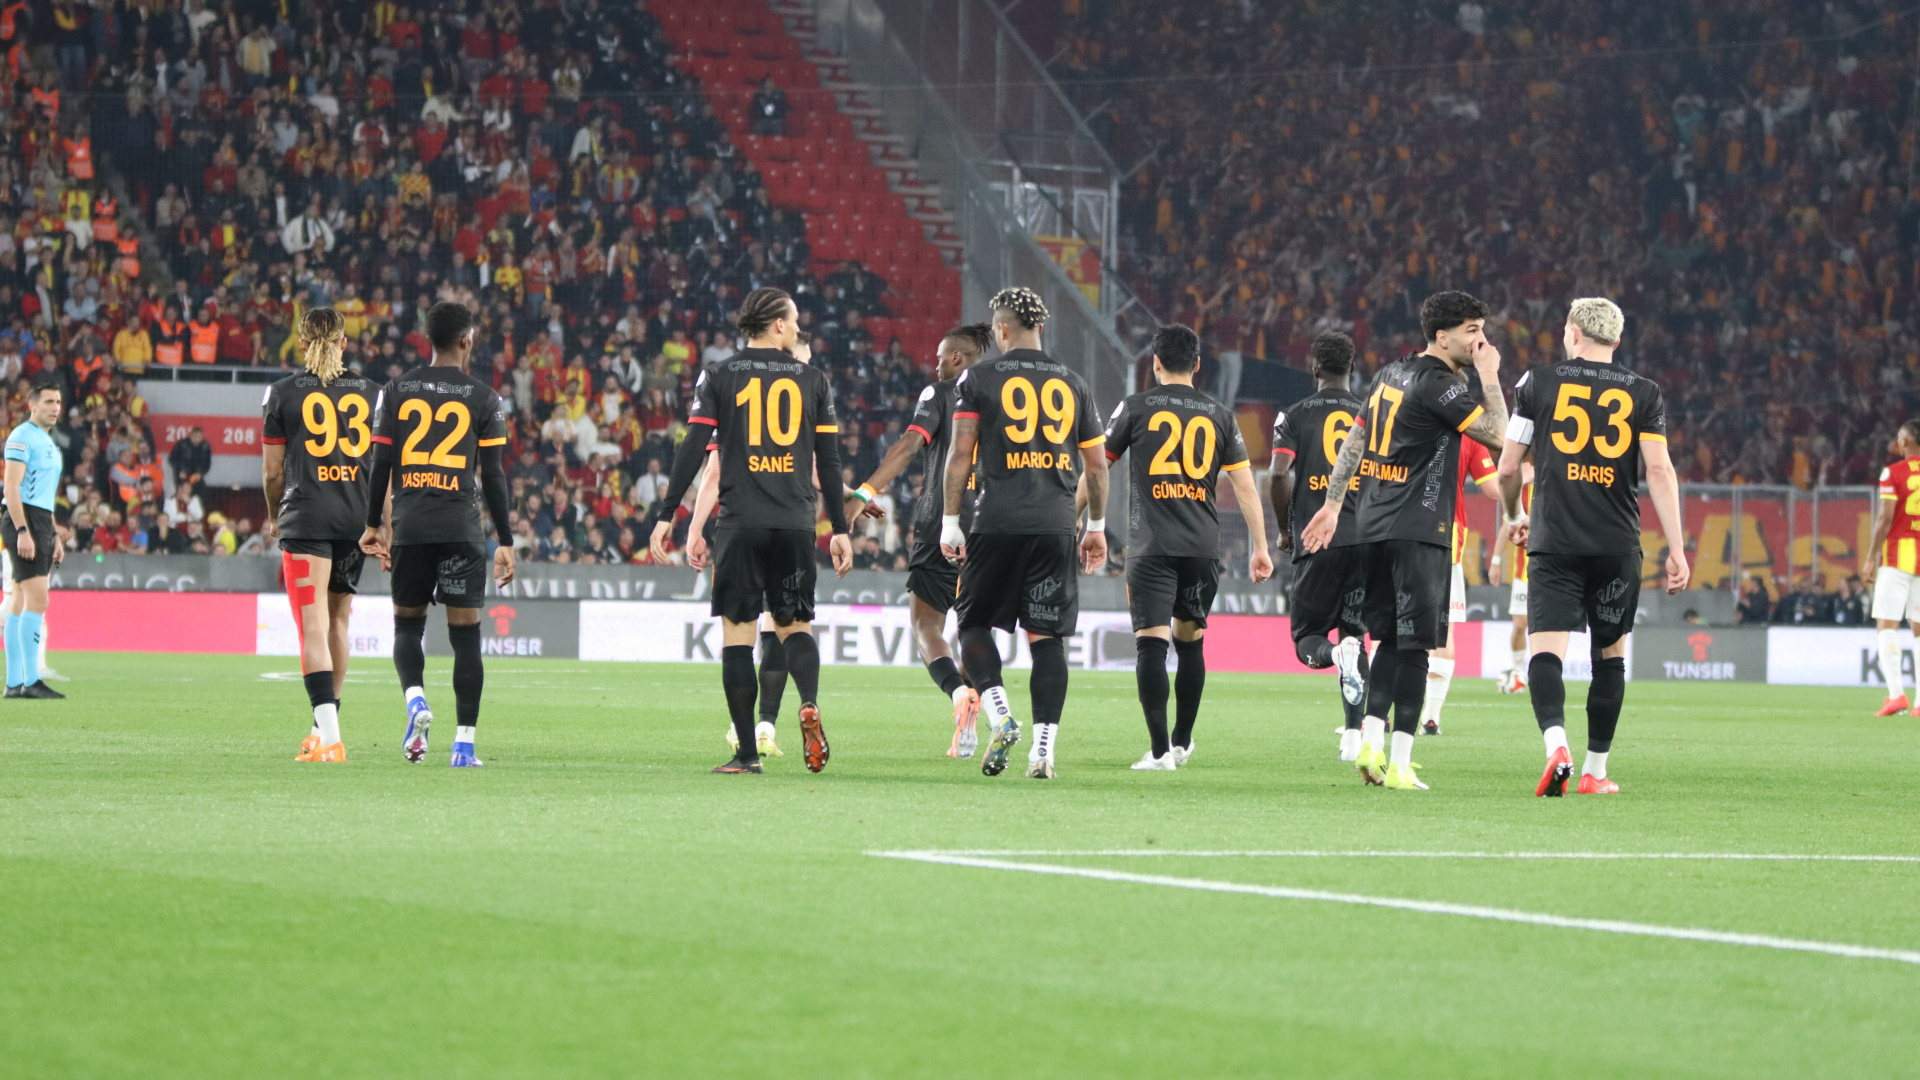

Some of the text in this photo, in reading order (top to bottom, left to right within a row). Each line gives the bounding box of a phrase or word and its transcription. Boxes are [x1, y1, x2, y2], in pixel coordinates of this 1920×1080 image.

[728, 360, 752, 371] CW
[995, 360, 1020, 372] CW
[1556, 365, 1582, 377] CW
[398, 381, 421, 392] CW
[1001, 376, 1075, 444] 99
[1145, 396, 1168, 406] CW
[736, 377, 803, 446] 10
[1368, 382, 1404, 457] 17
[1551, 383, 1634, 459] 53
[166, 426, 194, 442] 20
[302, 392, 371, 457] 93
[398, 398, 471, 469] 22
[223, 428, 255, 445] 208
[1148, 411, 1217, 480] 20
[1323, 411, 1354, 467] 6
[748, 452, 794, 473] SANÉ
[1006, 452, 1073, 471] MARIO JR.
[317, 465, 359, 482] BOEY
[1567, 463, 1615, 488] BARIŞ
[1663, 661, 1736, 680] TUNSER
